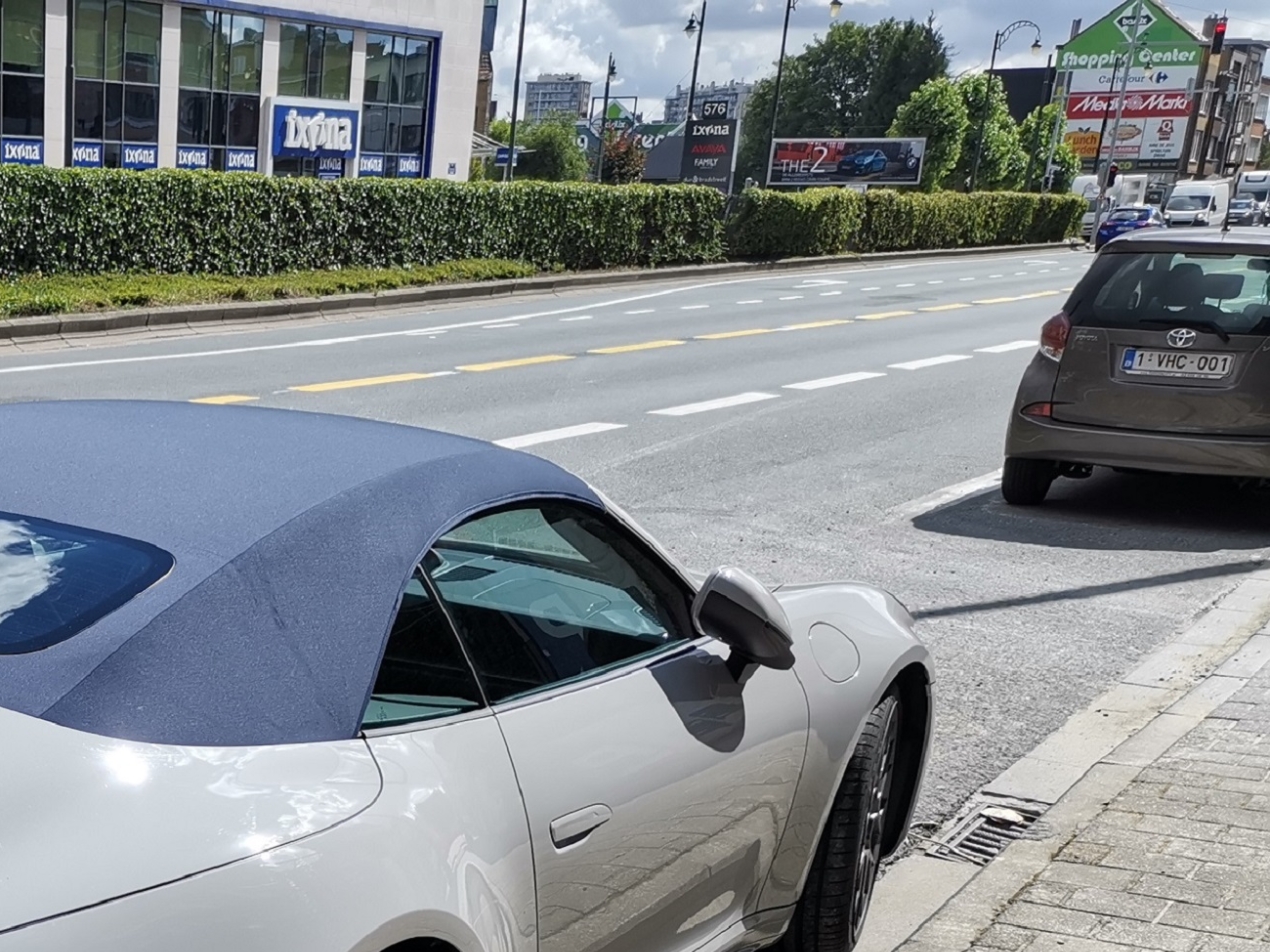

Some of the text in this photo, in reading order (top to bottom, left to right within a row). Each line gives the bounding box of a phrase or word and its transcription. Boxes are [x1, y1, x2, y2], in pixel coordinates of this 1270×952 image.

[1062, 49, 1196, 69] Shopping Center
[1098, 75, 1146, 85] Careour
[703, 103, 726, 116] 576
[692, 144, 726, 154] AVAYA
[694, 158, 719, 167] FAMILY
[781, 146, 828, 173] THE 2
[1137, 352, 1229, 373] 1-VHC-001
